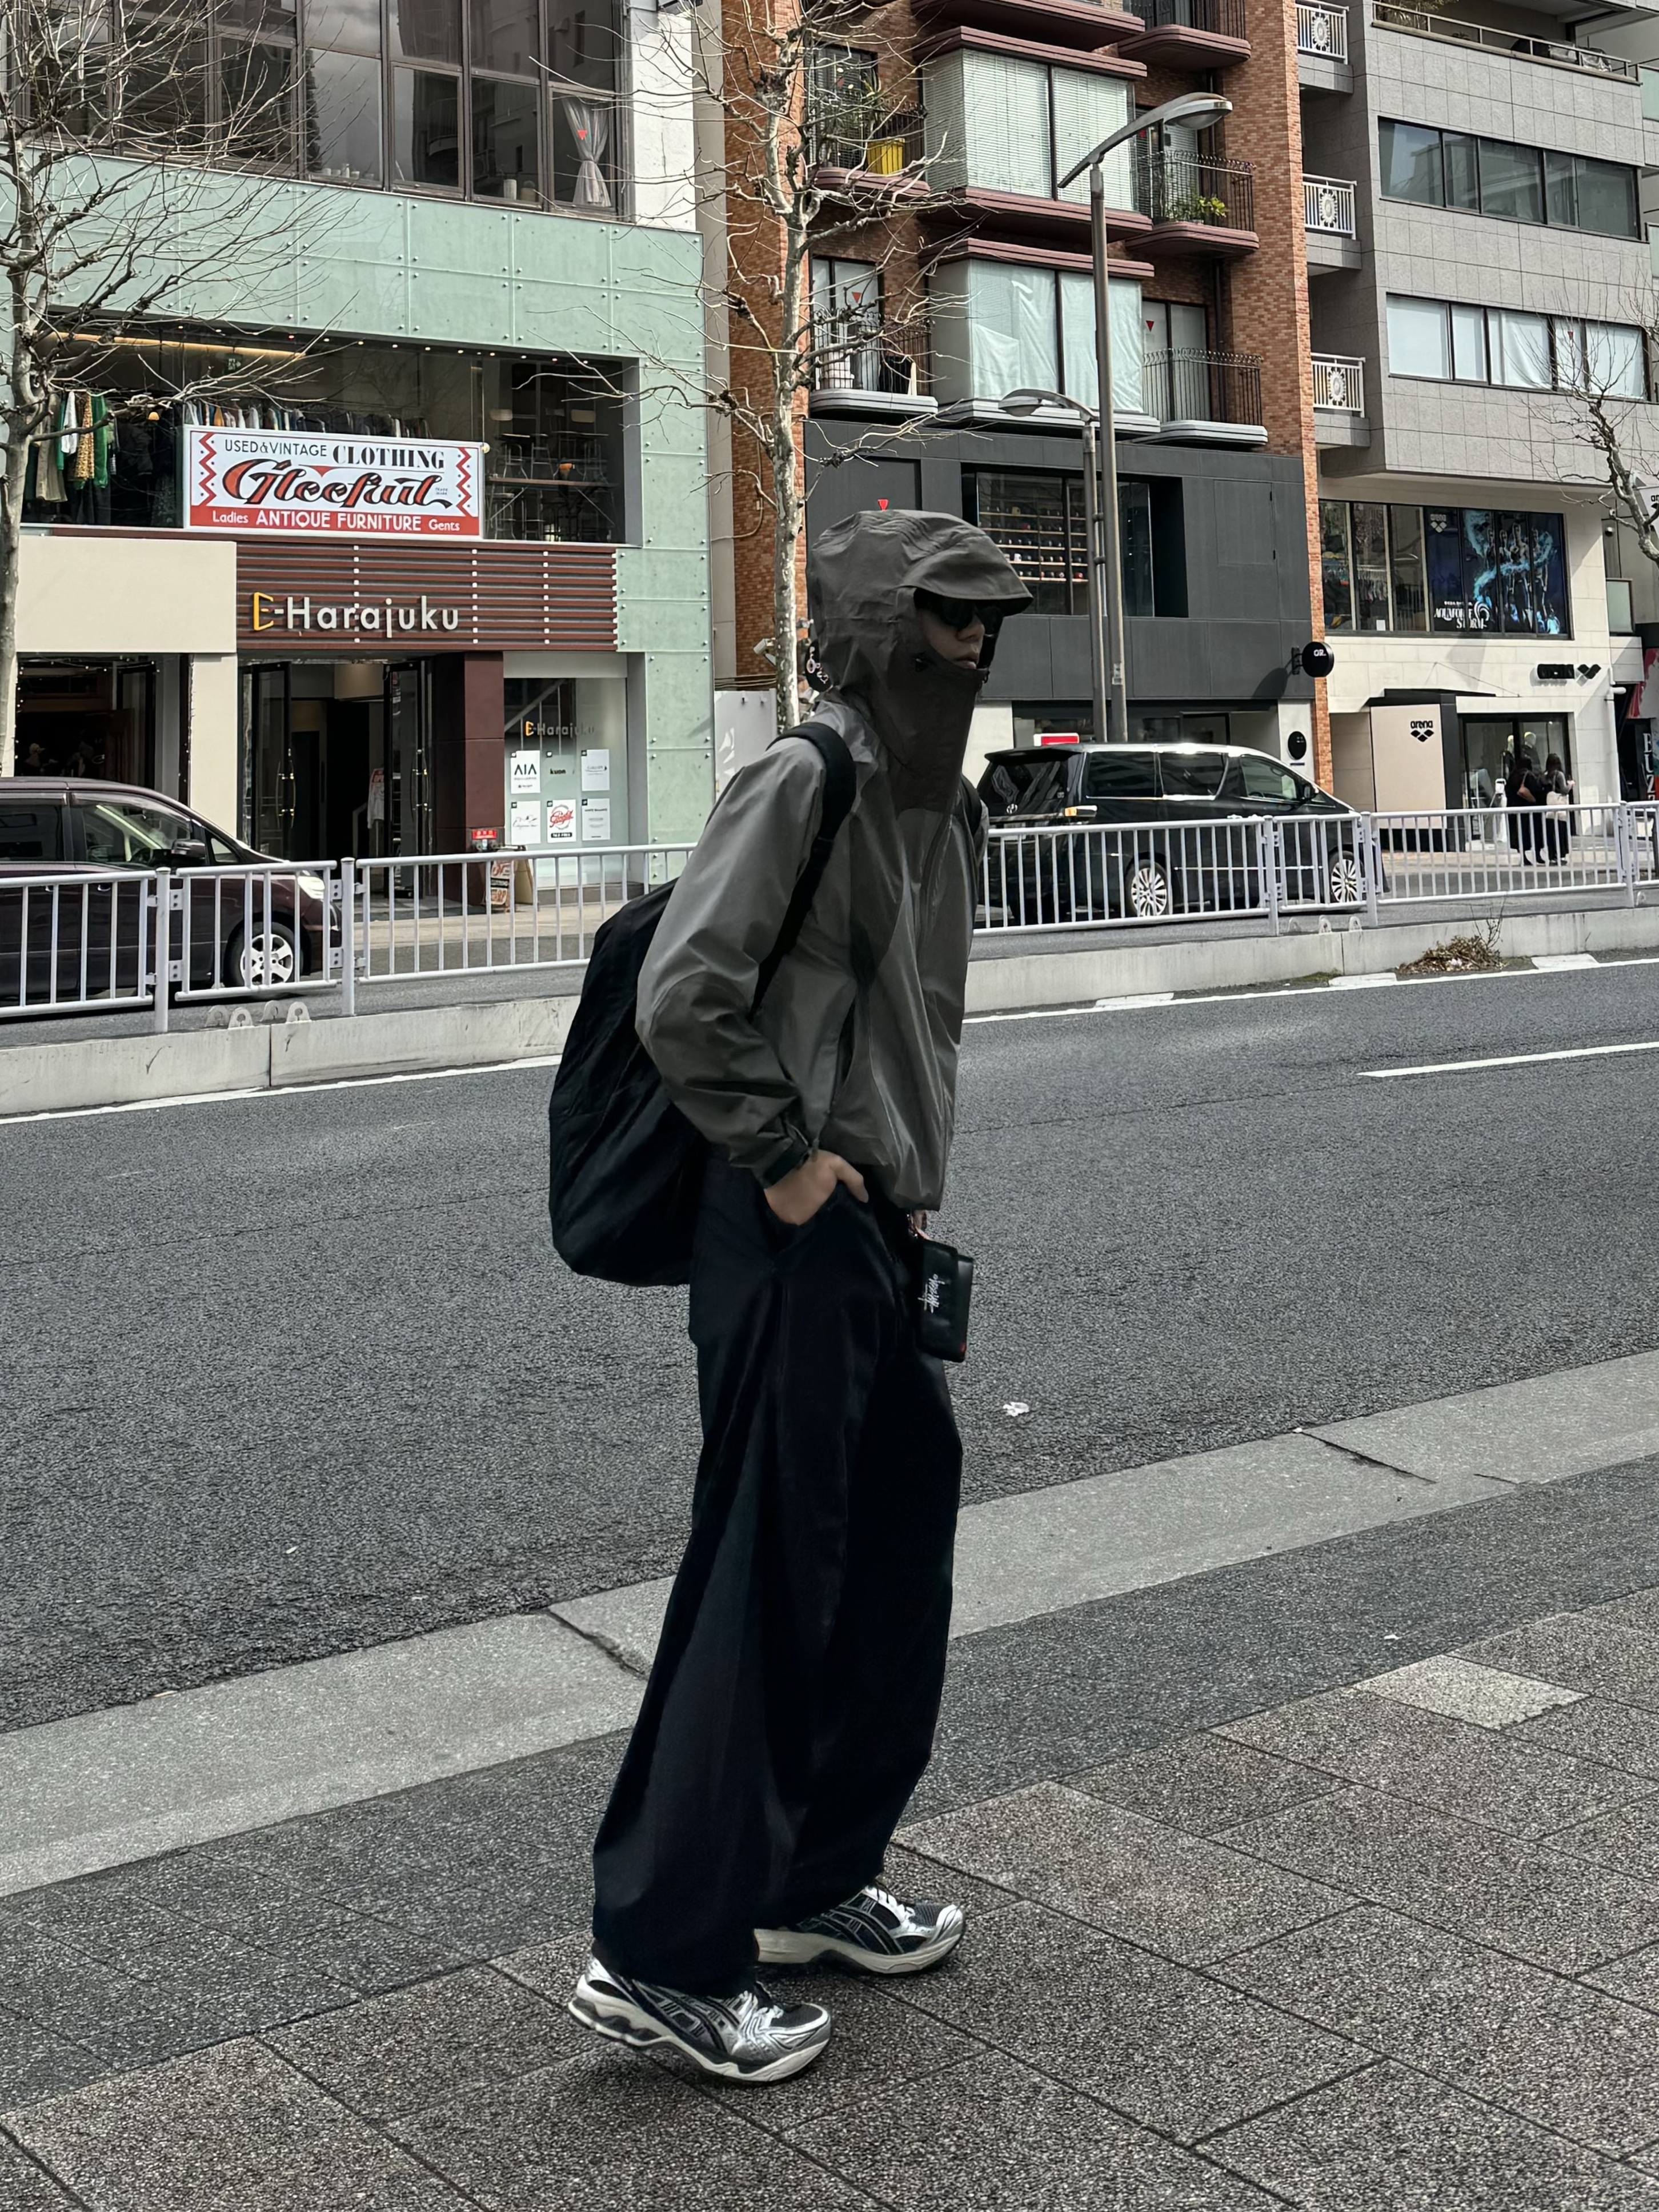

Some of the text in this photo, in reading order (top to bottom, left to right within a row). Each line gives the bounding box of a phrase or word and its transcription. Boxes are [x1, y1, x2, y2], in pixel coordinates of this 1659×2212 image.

[332, 445, 444, 469] CLOTHING
[222, 458, 453, 509] Gleeful
[213, 510, 460, 531] Ladies ANTIQUE FURNITURE Gents
[253, 592, 459, 638] E-Harajuku
[1410, 720, 1433, 729] arena
